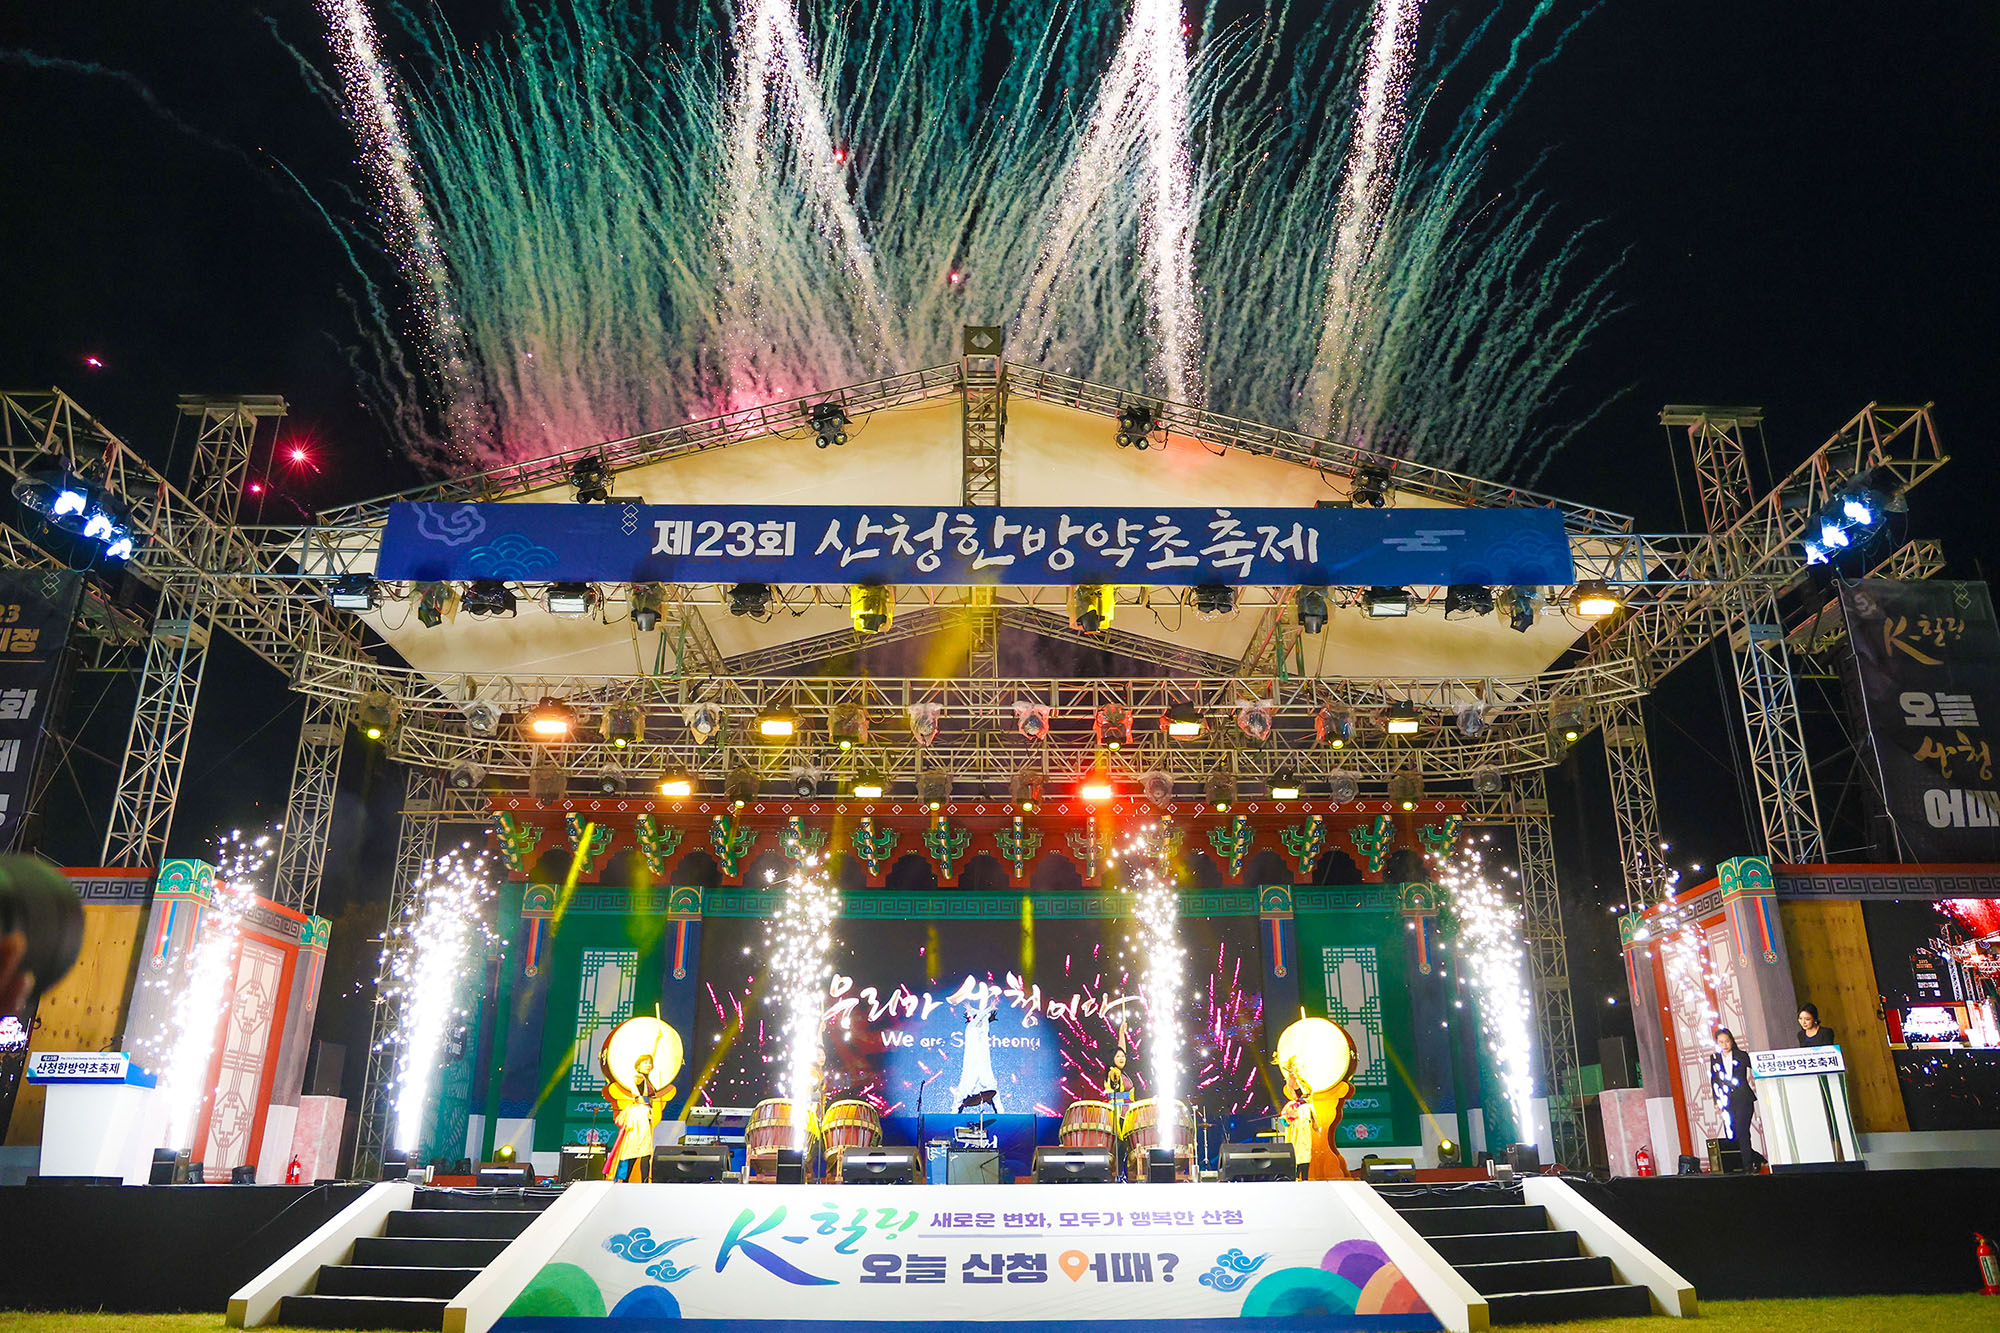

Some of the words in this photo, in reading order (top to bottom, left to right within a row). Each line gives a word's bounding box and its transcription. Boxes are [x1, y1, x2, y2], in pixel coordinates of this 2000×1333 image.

[652, 520, 796, 557] 제23회
[815, 509, 1319, 577] 산청한방약초축제
[1899, 691, 1980, 727] 오늘
[1913, 729, 1993, 781] 산청
[1923, 789, 2000, 828] 어때
[881, 1031, 914, 1047] We
[920, 1037, 946, 1048] are
[950, 1031, 1041, 1051] Sheong
[36, 1062, 120, 1074] 산청한방약초축제
[930, 1212, 995, 1228] 새로운
[1003, 1212, 1052, 1229] 변화,
[1059, 1212, 1124, 1227] 모두가
[1129, 1211, 1195, 1226] 행복한
[1201, 1210, 1244, 1225] 산청
[715, 1201, 919, 1285] K-힐링
[859, 1253, 947, 1284] 오늘
[962, 1253, 1048, 1284] 산청
